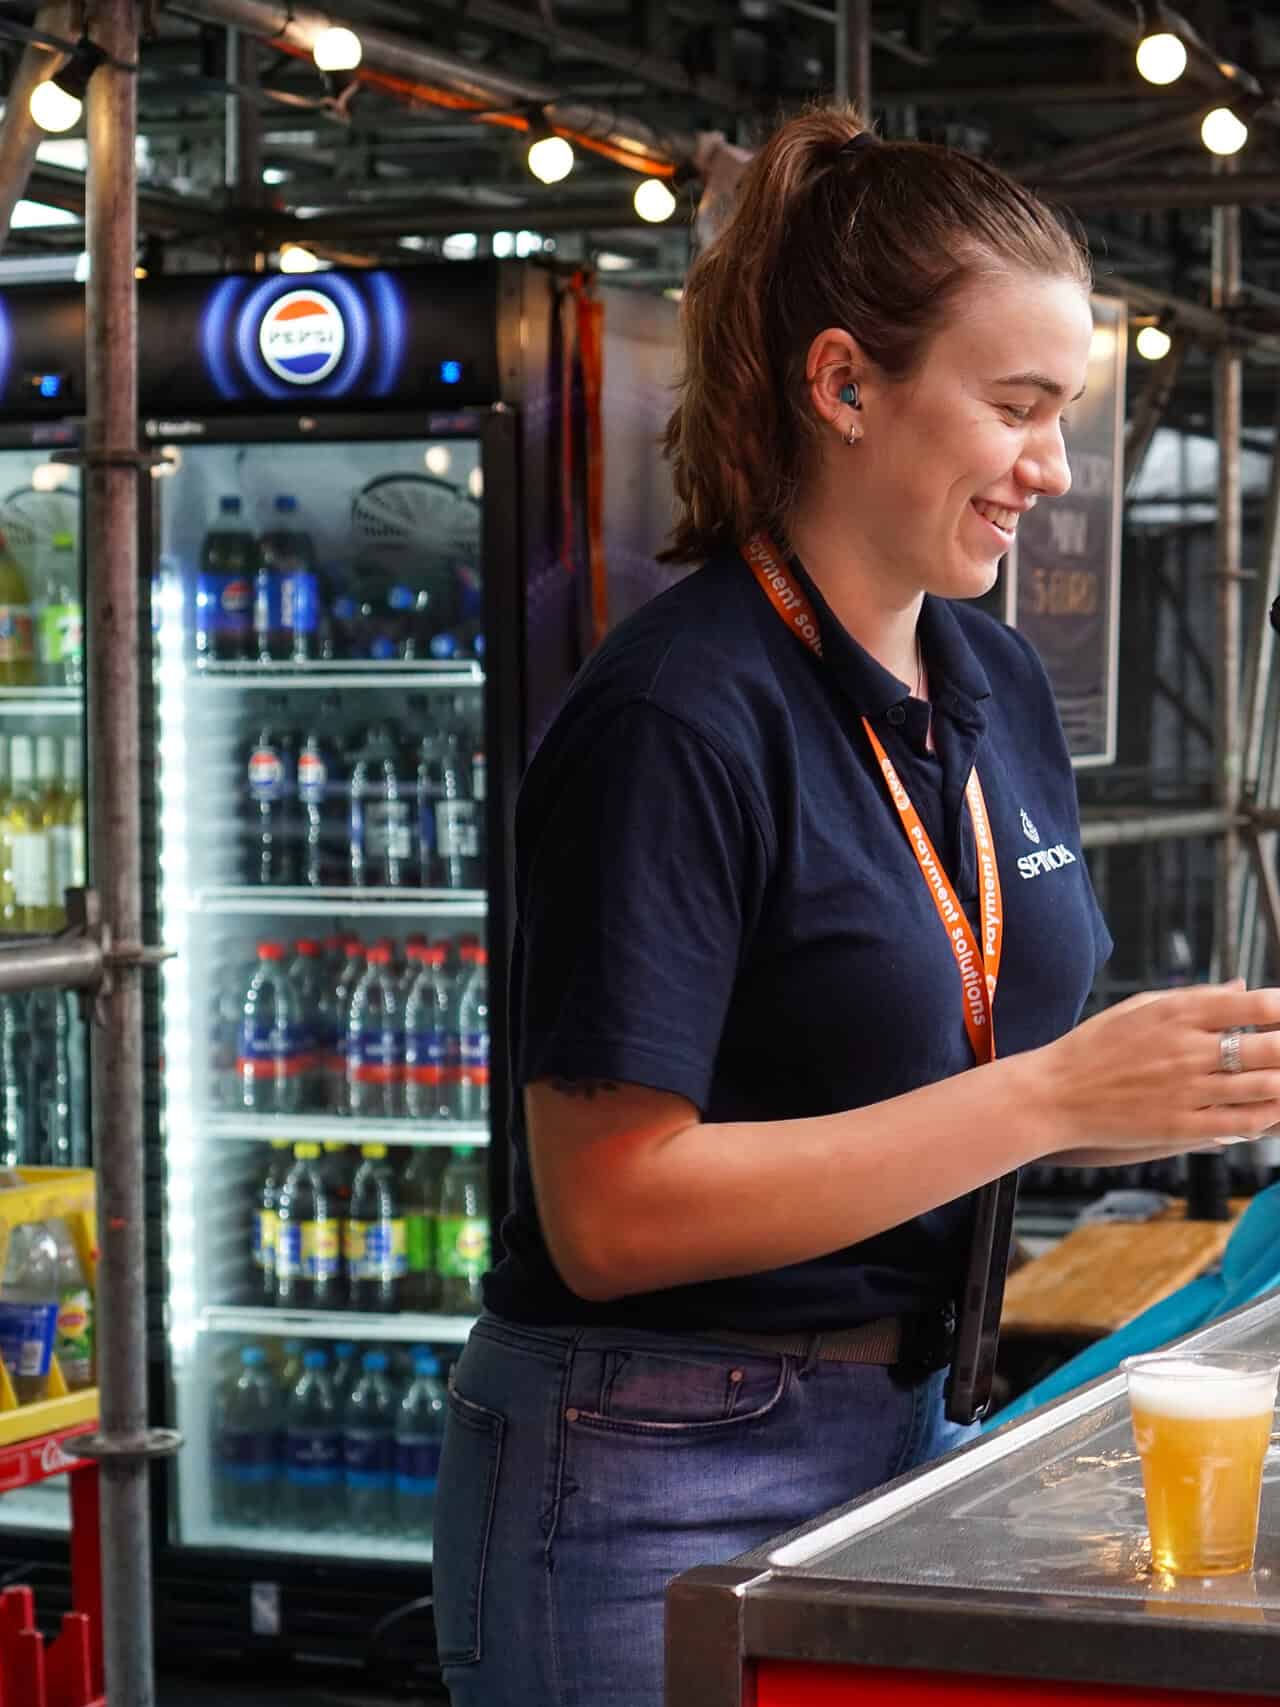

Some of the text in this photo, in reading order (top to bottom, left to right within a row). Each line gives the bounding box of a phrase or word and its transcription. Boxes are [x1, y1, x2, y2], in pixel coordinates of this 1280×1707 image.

[911, 826, 986, 1026] Payment solutions
[981, 854, 1001, 957] Payment
